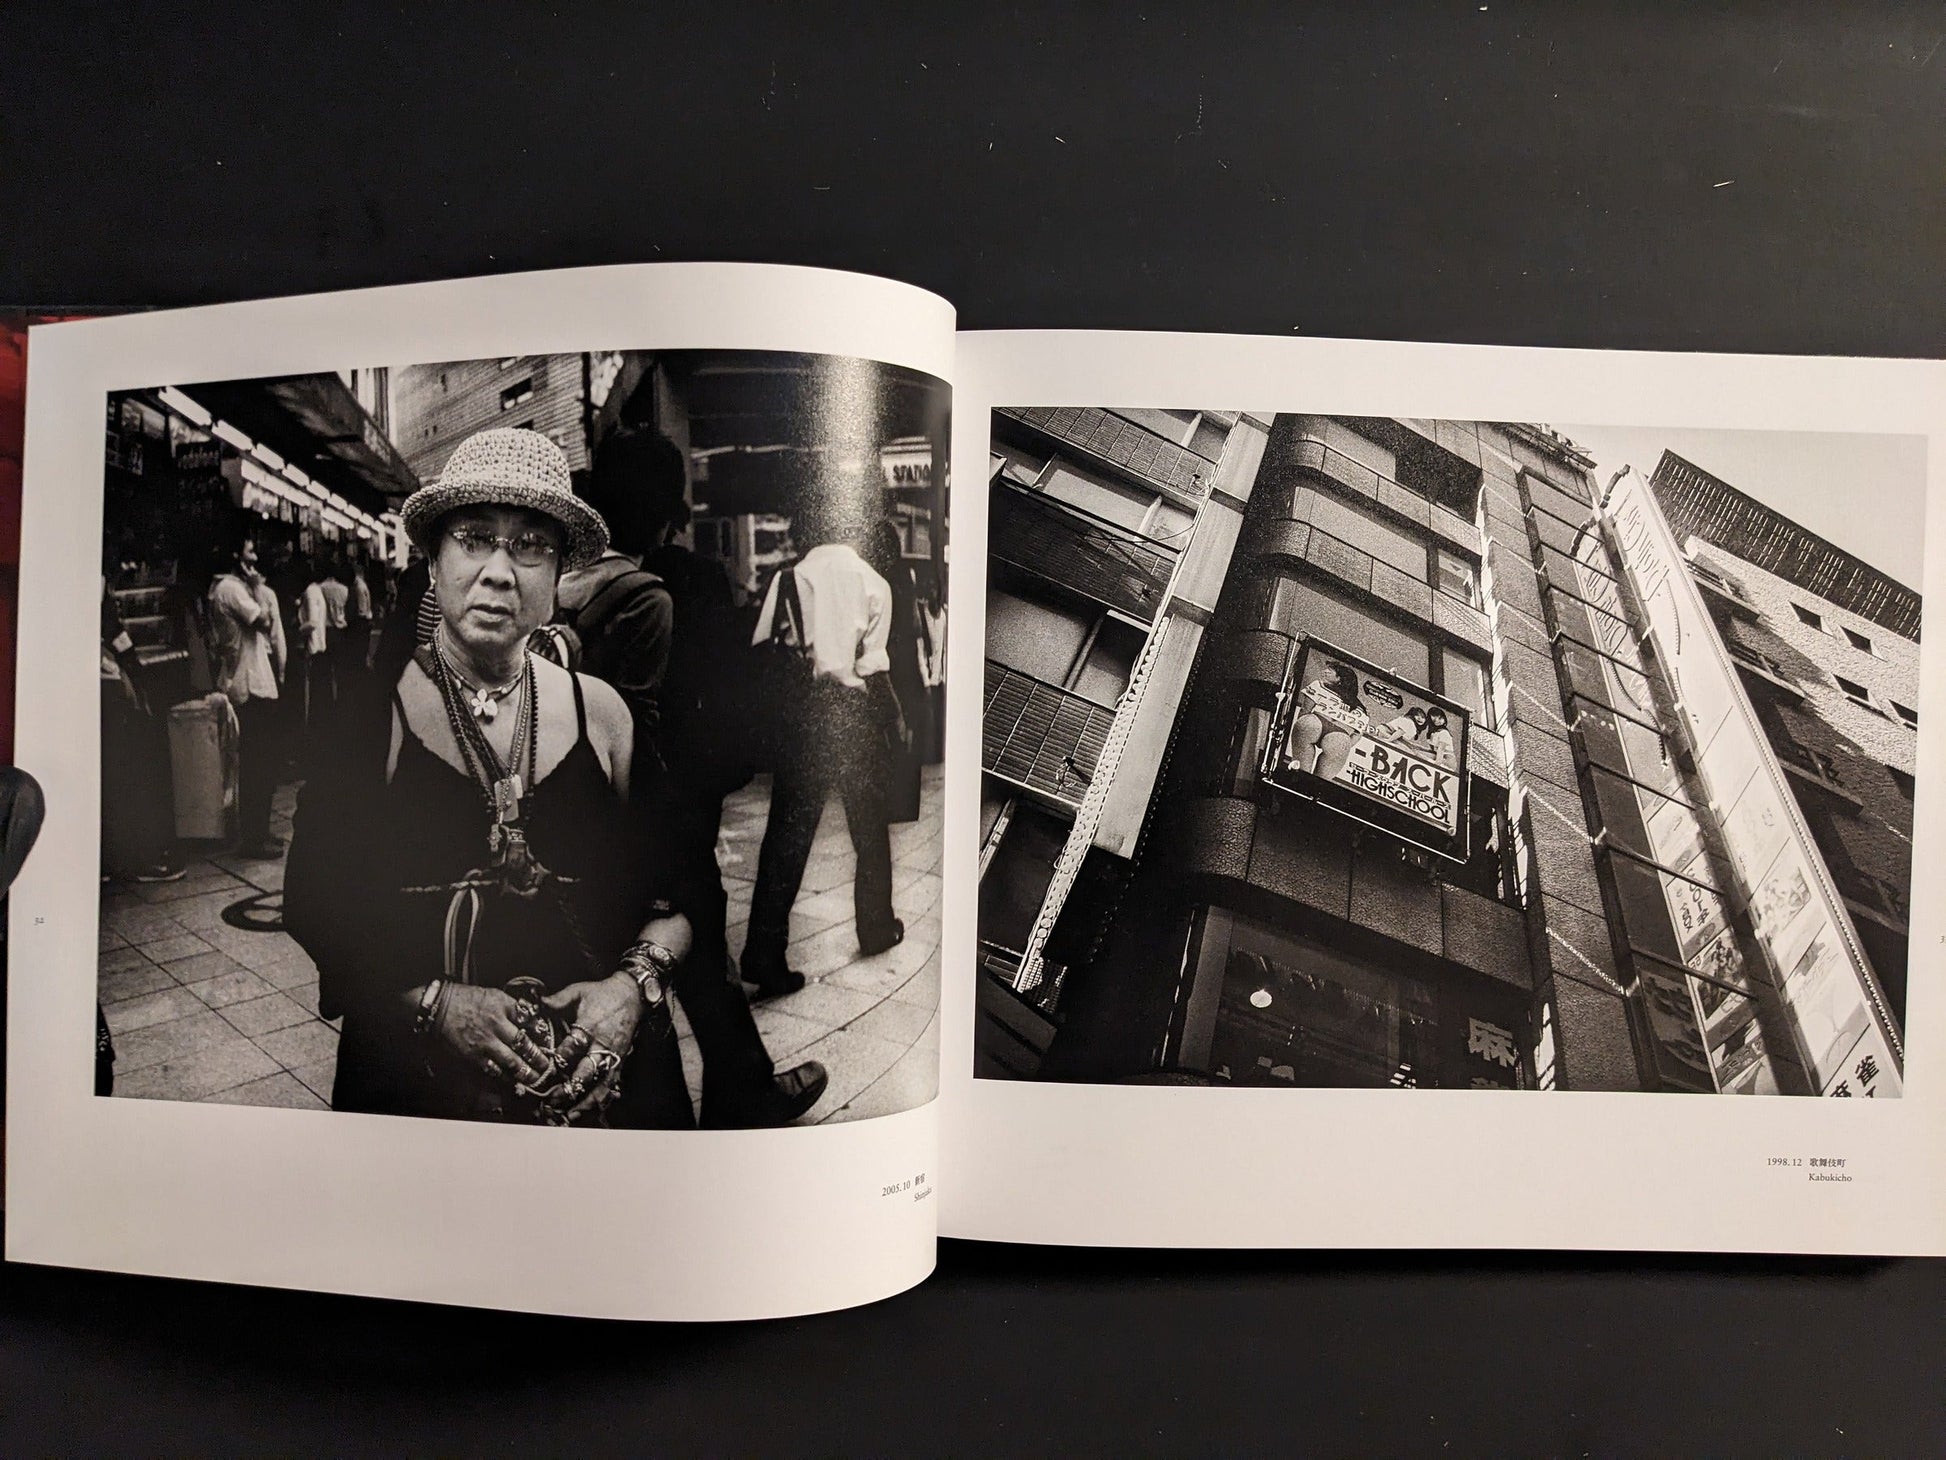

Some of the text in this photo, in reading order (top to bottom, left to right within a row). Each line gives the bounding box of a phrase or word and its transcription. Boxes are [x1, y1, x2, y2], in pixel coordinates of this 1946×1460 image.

[1809, 1158, 1847, 1167] 歌舞伎町
[1808, 1173, 1853, 1182] Kabukicho
[882, 1180, 910, 1196] 2005.10
